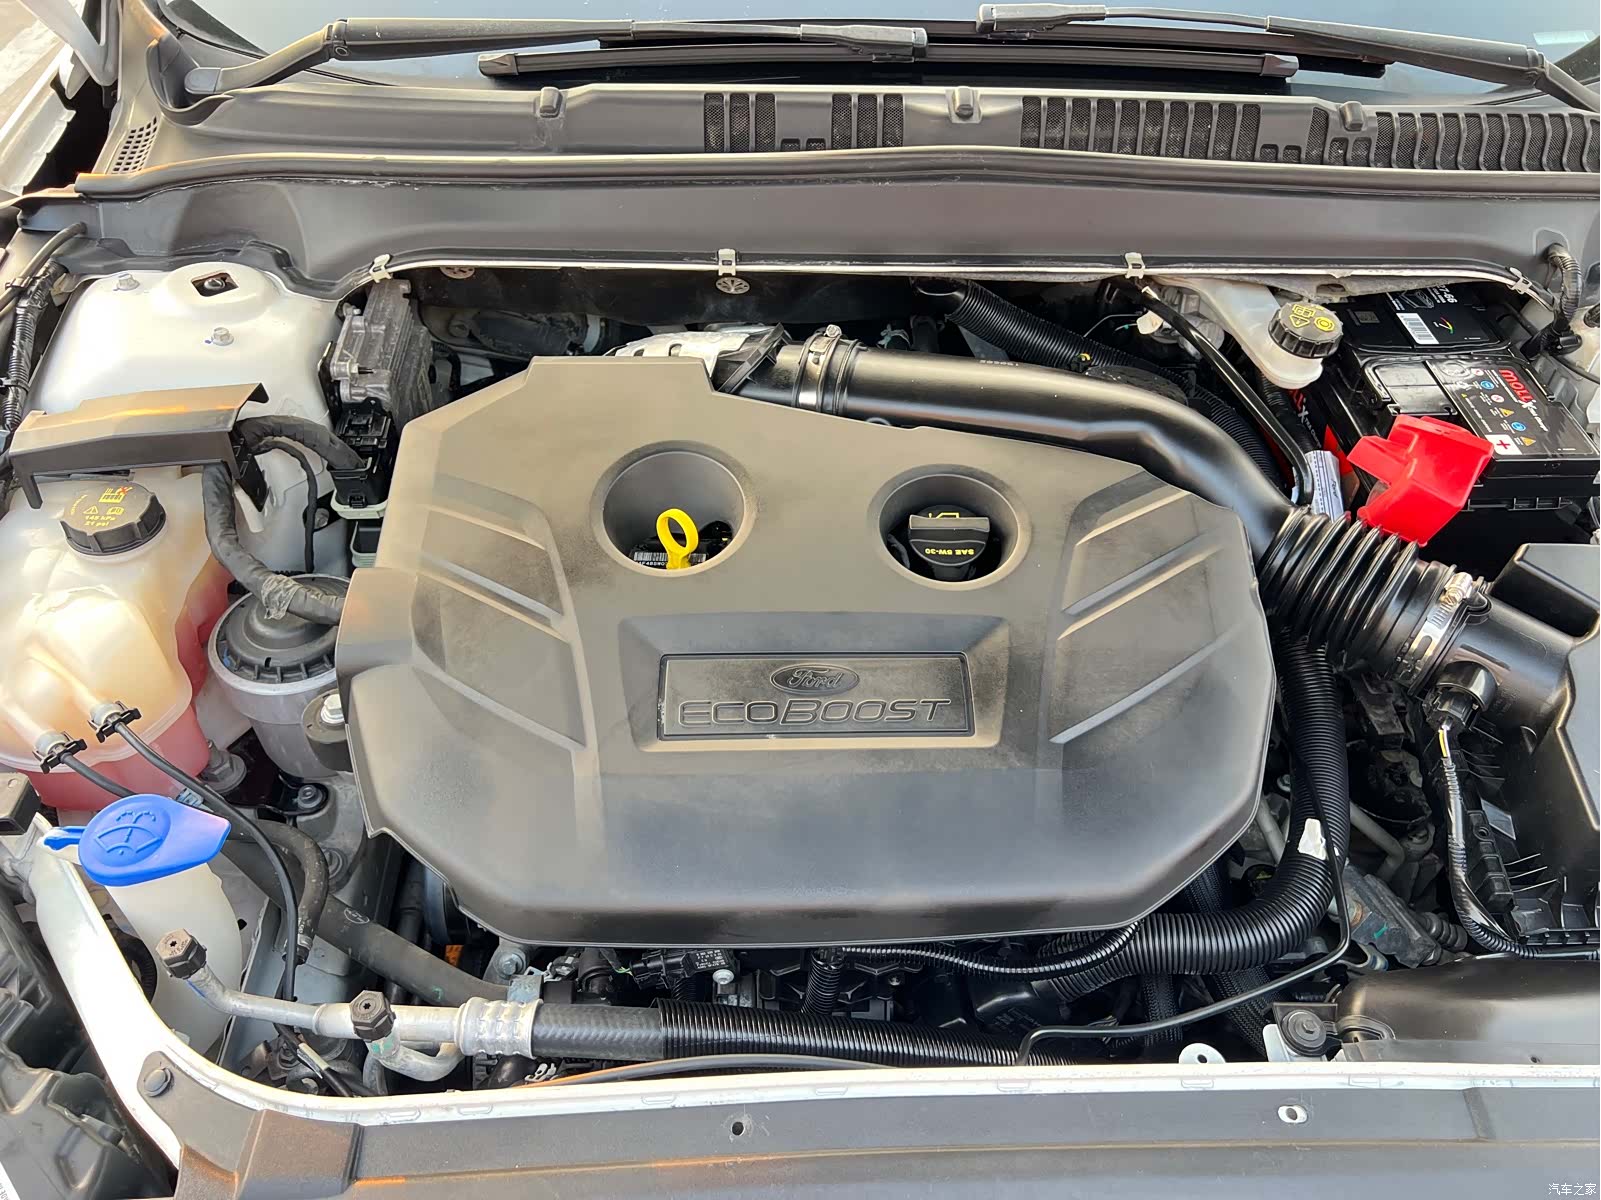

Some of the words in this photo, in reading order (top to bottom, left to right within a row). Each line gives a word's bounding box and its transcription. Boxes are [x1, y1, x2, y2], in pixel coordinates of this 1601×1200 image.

[924, 547, 953, 556] 5W-30
[954, 548, 975, 556] SAE
[787, 667, 845, 690] Ford
